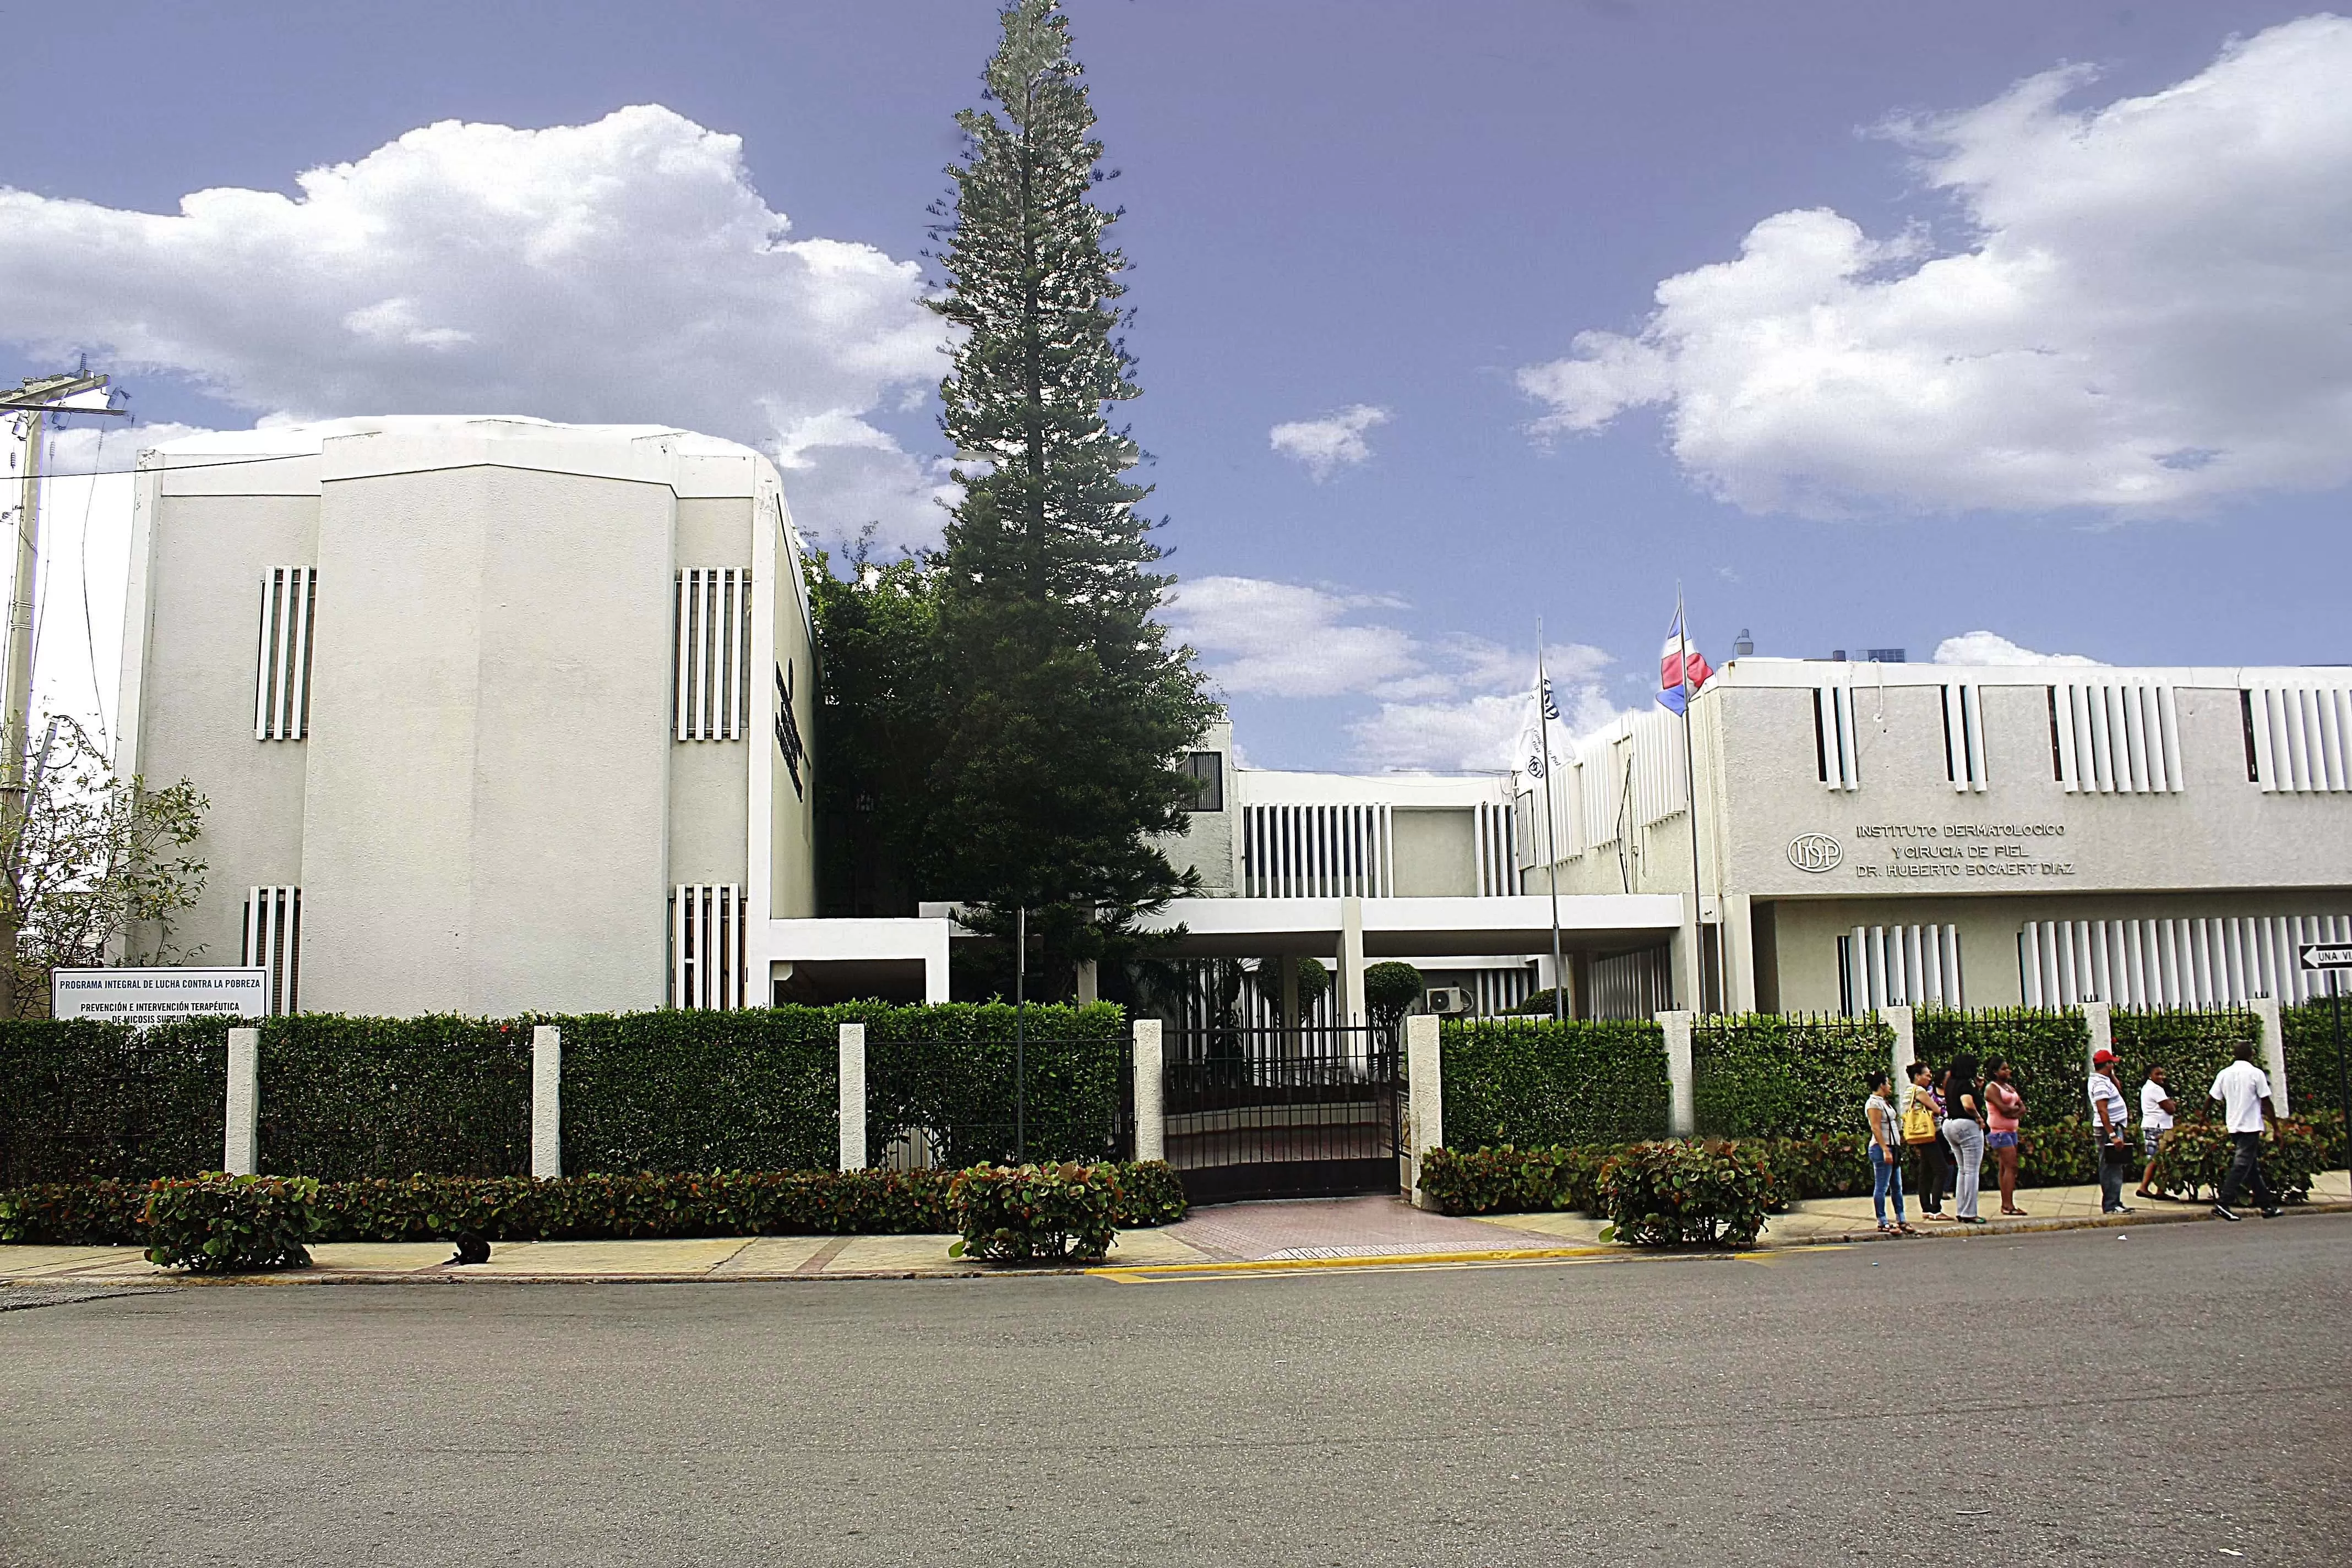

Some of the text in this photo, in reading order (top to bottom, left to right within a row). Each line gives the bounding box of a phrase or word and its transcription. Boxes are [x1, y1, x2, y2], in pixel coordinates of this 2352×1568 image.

[1856, 824, 2066, 837] INSTITUTO DERMATOLOGICO
[1892, 844, 2030, 858] Y CIRUGIA DE PIEL
[1856, 862, 2076, 877] DR. HUBERTO BOGAERT DIAZ
[2318, 951, 2352, 961] UNA VI
[59, 979, 260, 989] PROGRAMA INTEGRAL DE LUCHA CONTRA LA POBREZA
[80, 1000, 239, 1012] PREVENCIÓN E INTERVENCIÓN TERAPÉUTICA
[112, 1015, 122, 1024] DE
[124, 1015, 155, 1023] MICOSIS
